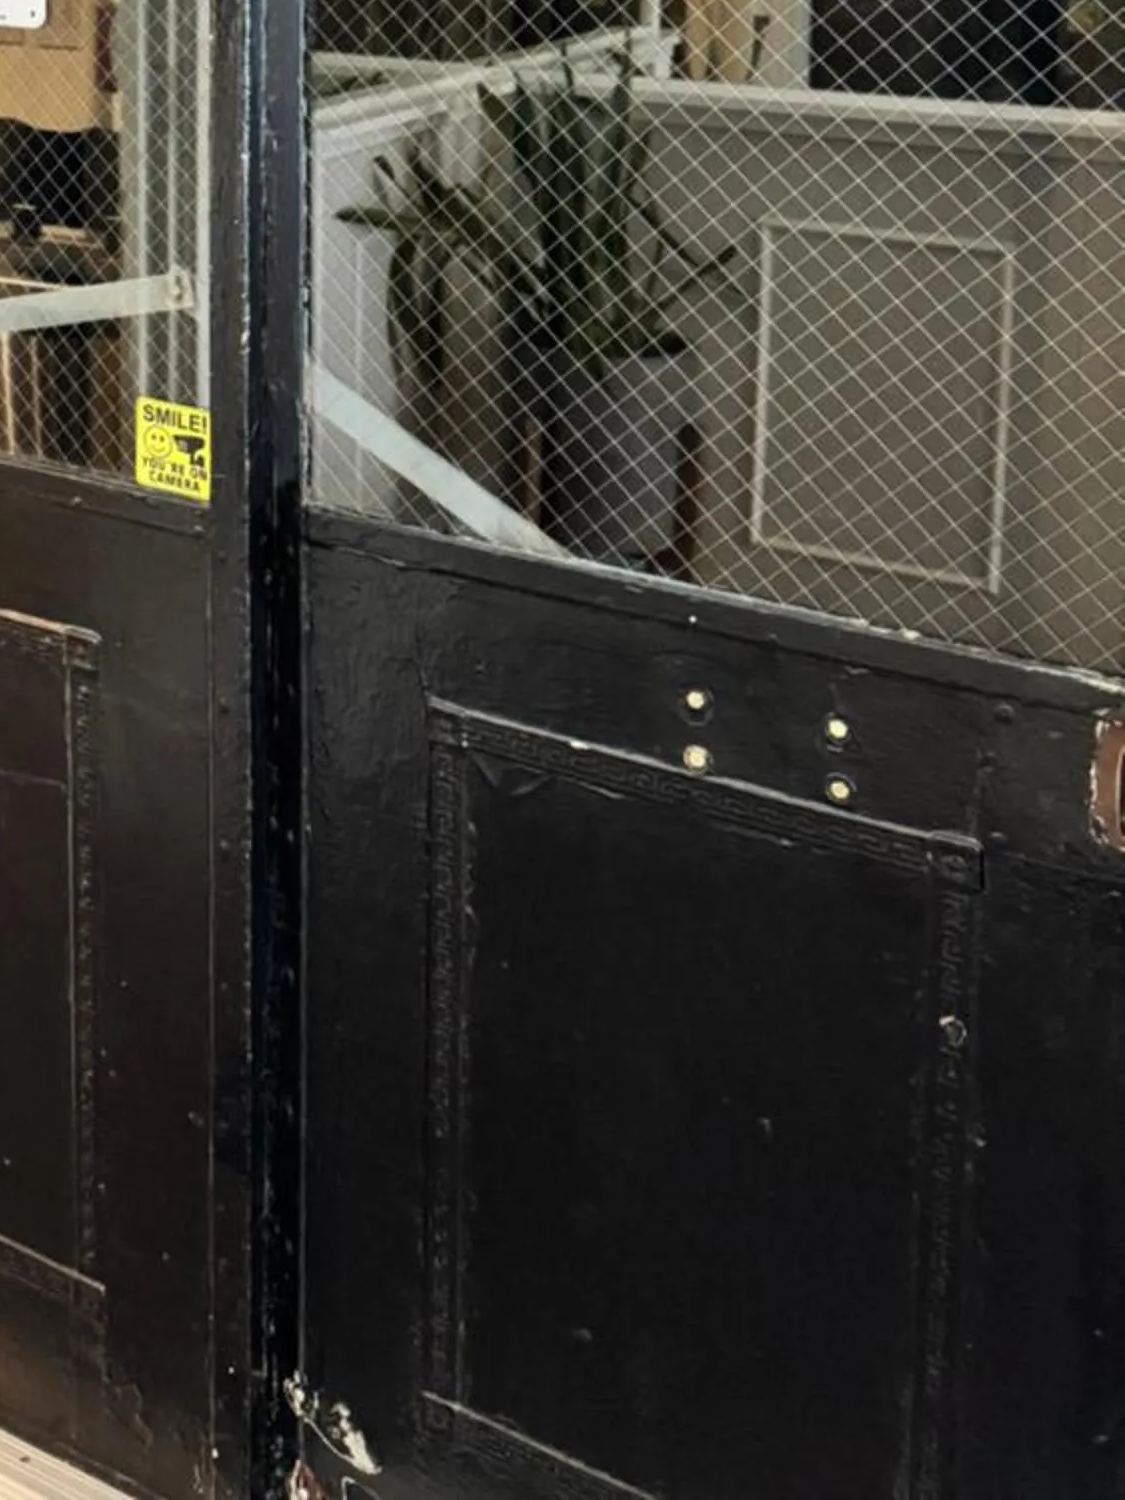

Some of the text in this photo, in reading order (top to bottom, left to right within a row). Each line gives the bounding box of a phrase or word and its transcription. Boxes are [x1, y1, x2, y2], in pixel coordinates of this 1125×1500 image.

[143, 404, 207, 434] SMILE!
[149, 470, 201, 492] CAMERA
[190, 465, 207, 481] ON
